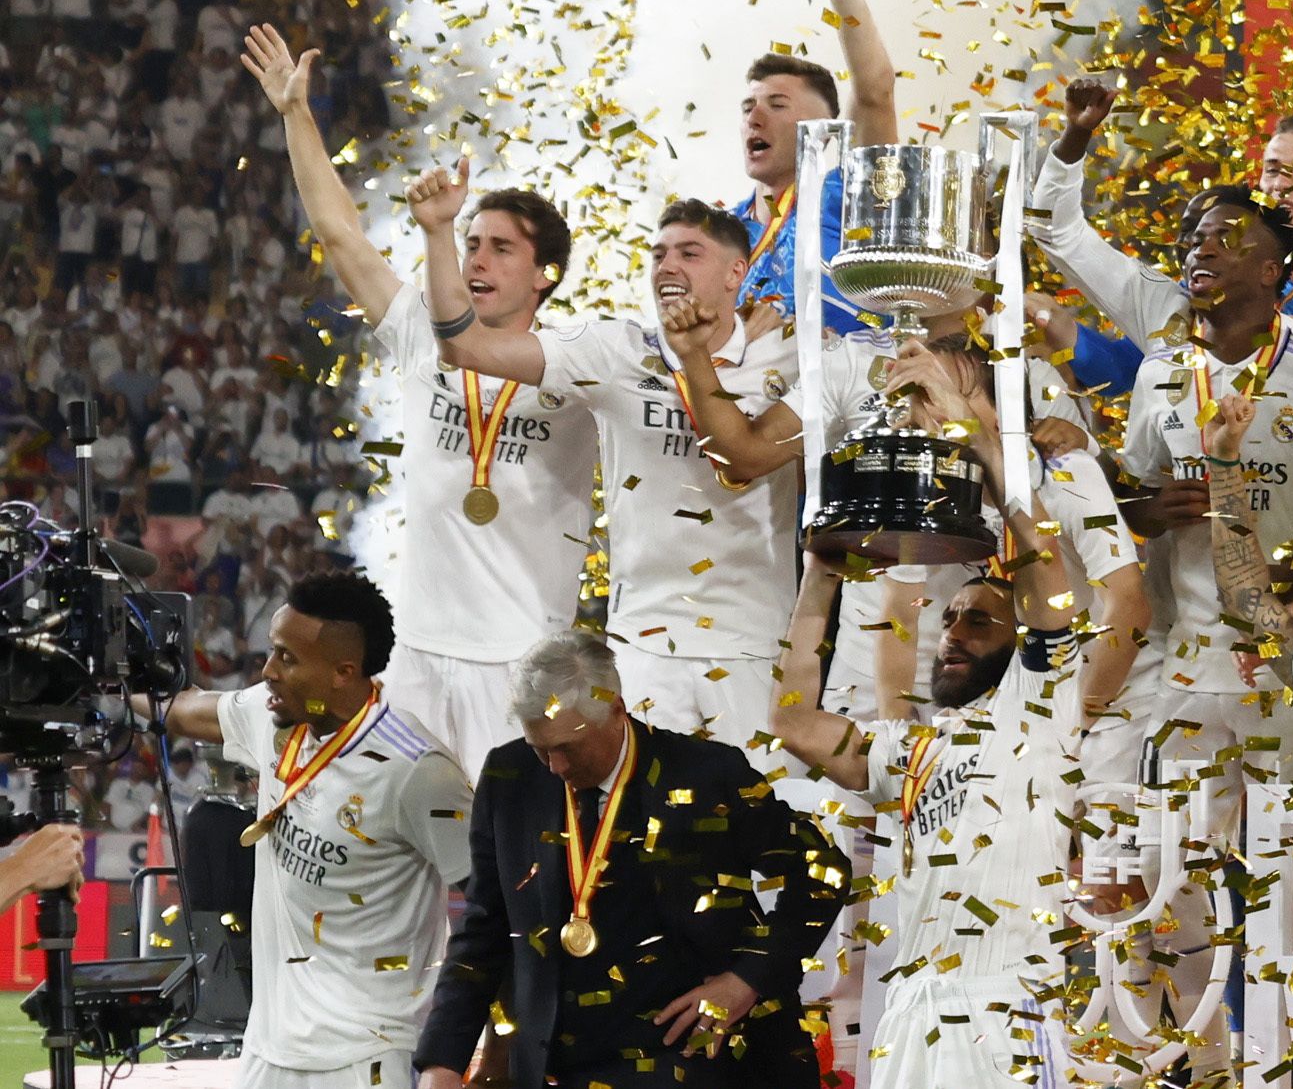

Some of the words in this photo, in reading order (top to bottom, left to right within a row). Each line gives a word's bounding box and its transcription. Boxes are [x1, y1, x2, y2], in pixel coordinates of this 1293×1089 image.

[436, 427, 465, 454] FLY
[662, 434, 694, 458] FLY
[281, 847, 327, 887] BETTER
